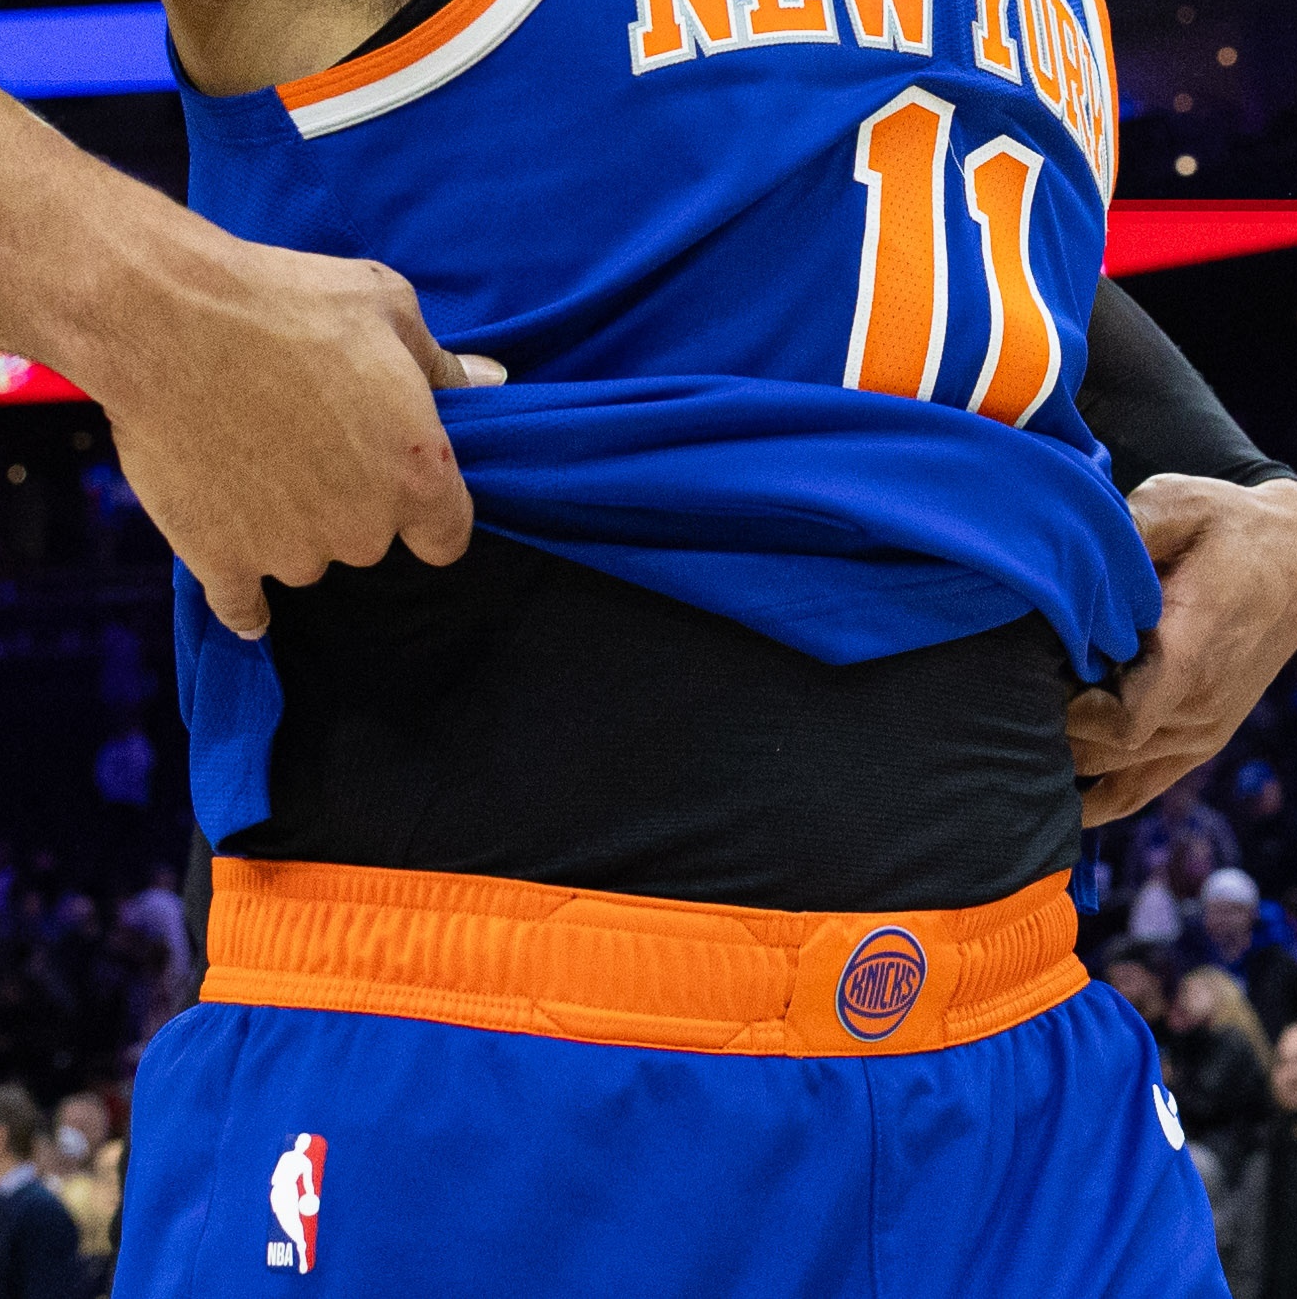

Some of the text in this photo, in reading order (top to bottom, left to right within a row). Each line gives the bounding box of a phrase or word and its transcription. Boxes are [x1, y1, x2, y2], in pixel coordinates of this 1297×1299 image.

[842, 85, 1062, 429] 11
[848, 961, 917, 1011] KNICKS
[267, 1241, 294, 1267] NBA
